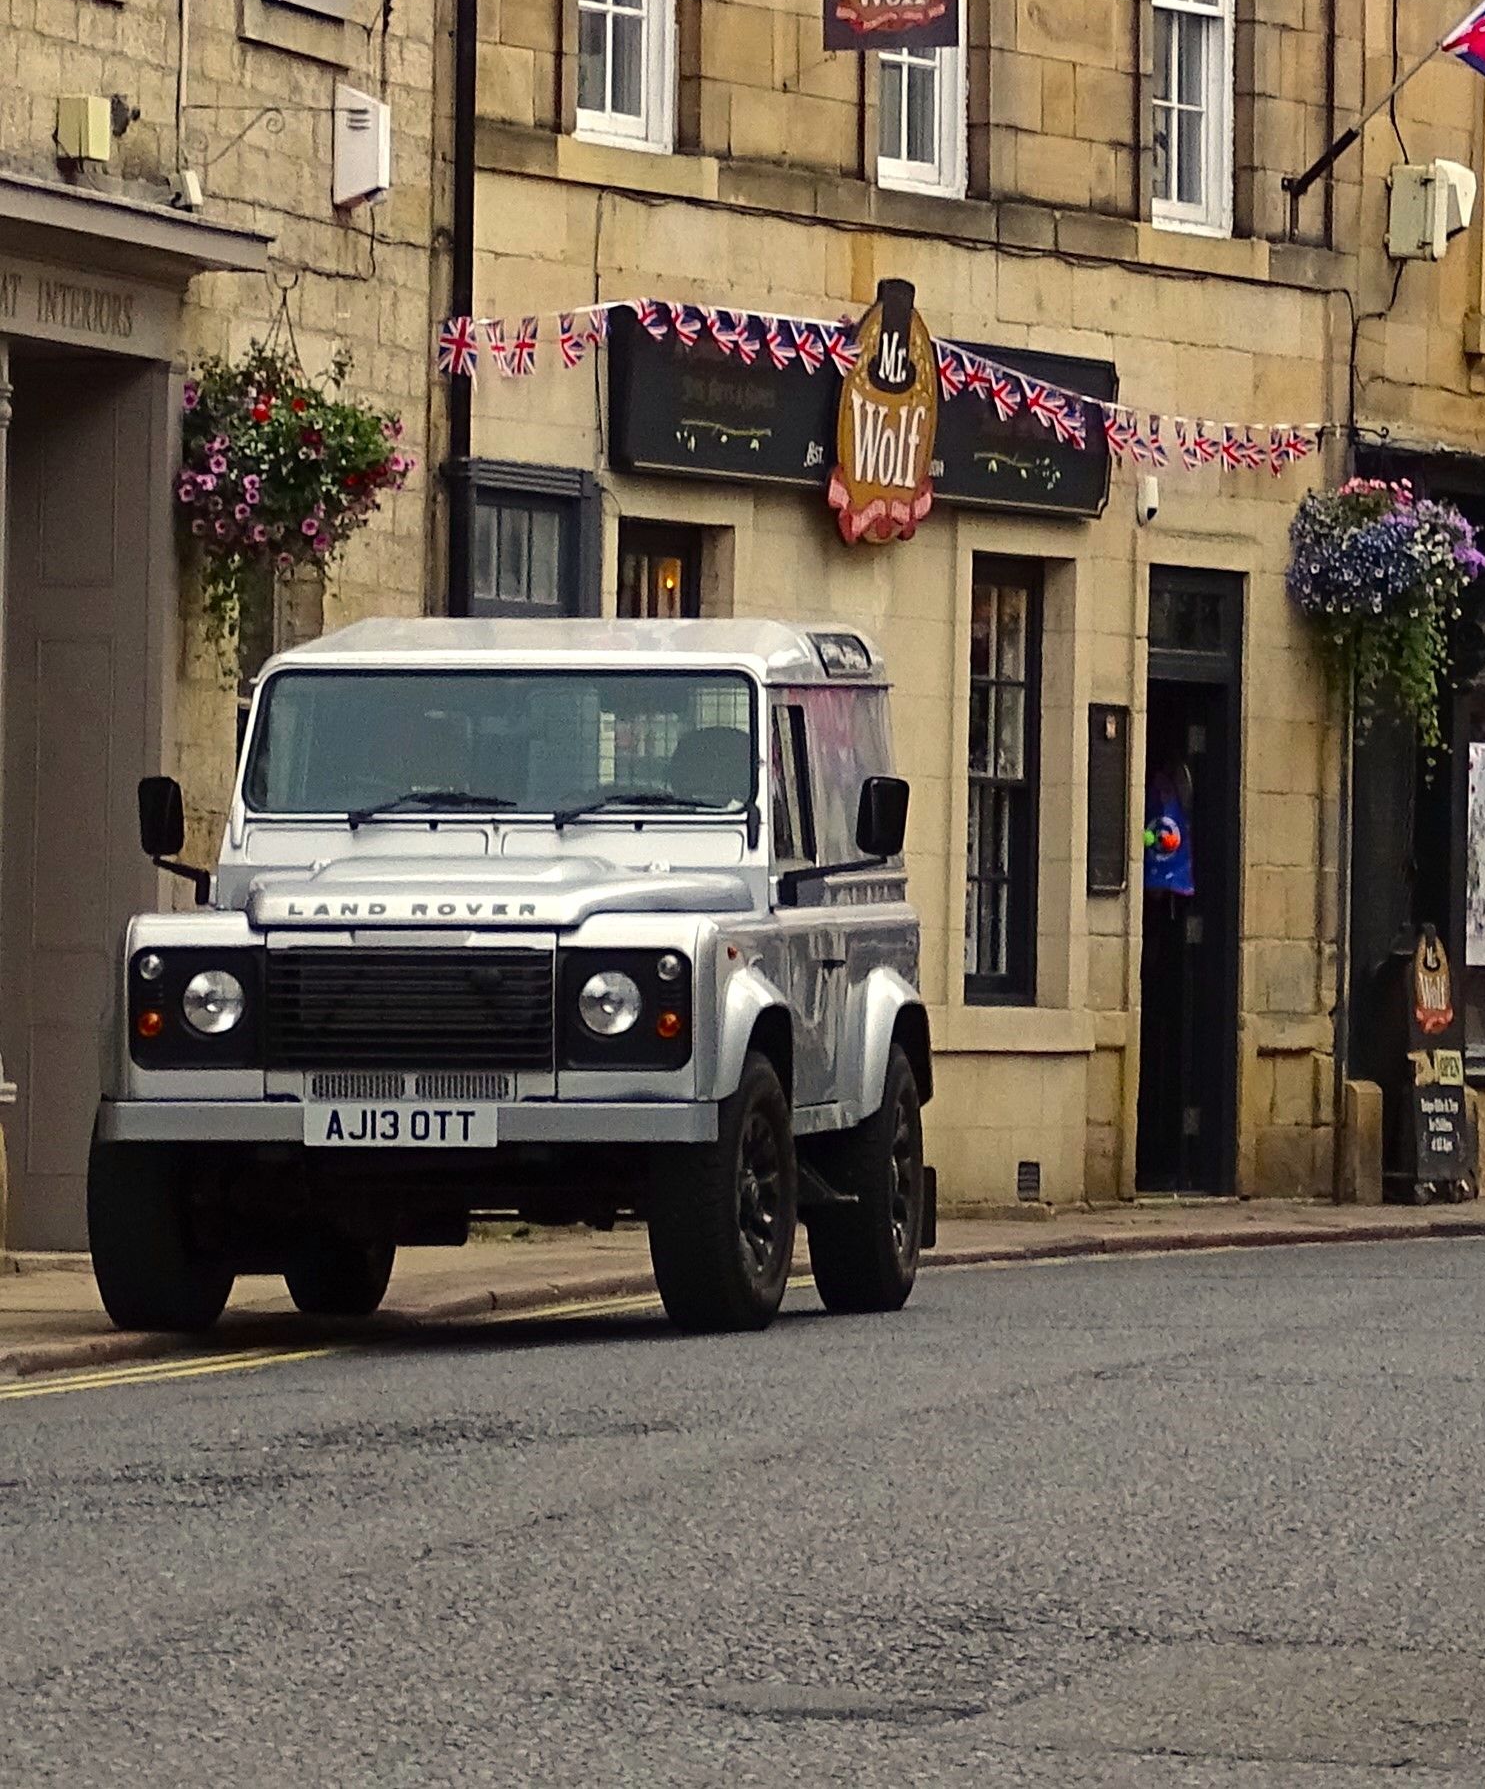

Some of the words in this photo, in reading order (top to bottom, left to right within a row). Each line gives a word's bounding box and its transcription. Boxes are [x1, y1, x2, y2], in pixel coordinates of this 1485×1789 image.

[37, 278, 134, 338] INTERIORS
[878, 331, 907, 383] Mr.
[851, 388, 926, 488] Wolf
[288, 903, 387, 916] LAND
[411, 903, 536, 916] ROVER
[326, 1110, 399, 1141] AJ13
[410, 1110, 475, 1142] OTT
